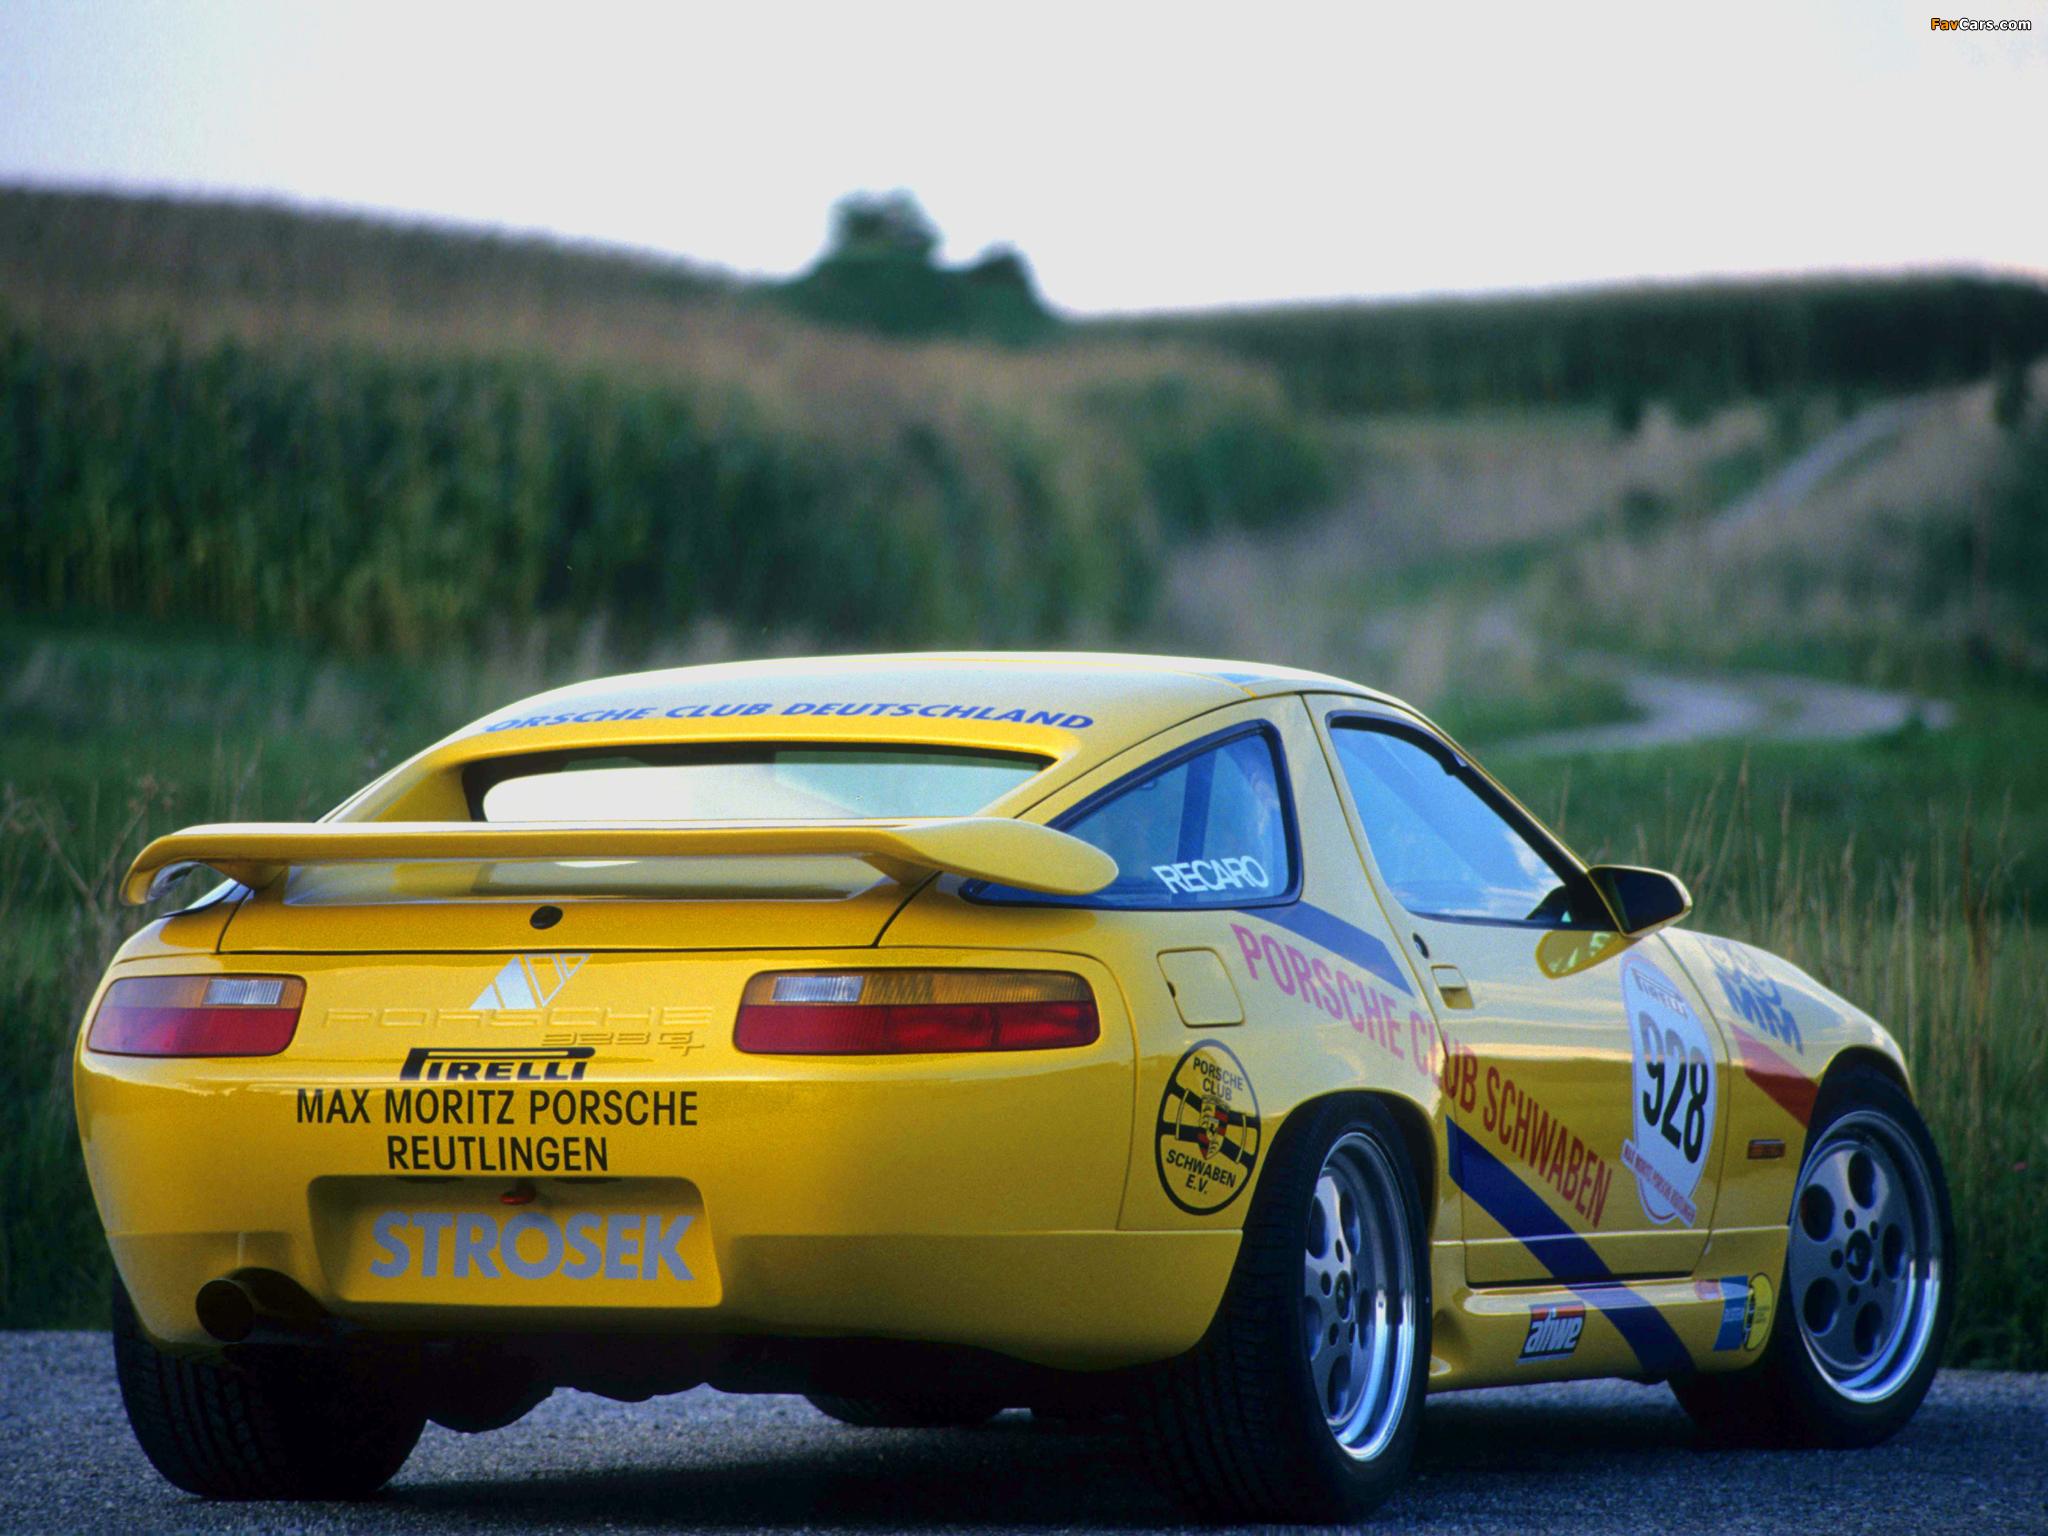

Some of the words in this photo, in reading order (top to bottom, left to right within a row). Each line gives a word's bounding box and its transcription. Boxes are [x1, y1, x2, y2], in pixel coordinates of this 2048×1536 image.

[483, 707, 658, 732] ORSCHE
[665, 703, 773, 718] CLUB
[781, 702, 1094, 730] DEUTSCHLAND
[1151, 856, 1269, 894] RECARO
[321, 1006, 713, 1028] PORSCHE
[540, 1031, 651, 1047] 928
[399, 1047, 596, 1081] PIRELLI
[1192, 1057, 1244, 1092] PORSCHE
[1230, 922, 1405, 1060] PORSCHE
[1409, 1010, 1478, 1114] CLUB
[1482, 1066, 1612, 1229] SCHWABEN
[1202, 1077, 1232, 1101] CLUB
[1638, 1010, 1709, 1164] 928
[297, 1088, 371, 1124] MAX
[384, 1088, 516, 1125] MORITZ
[529, 1090, 698, 1126] PORSCHE
[387, 1135, 609, 1172] REUTLINGEN
[1165, 1149, 1237, 1188] SCHWABEN
[1185, 1173, 1208, 1195] E.V.
[368, 1210, 696, 1282] STROSEK
